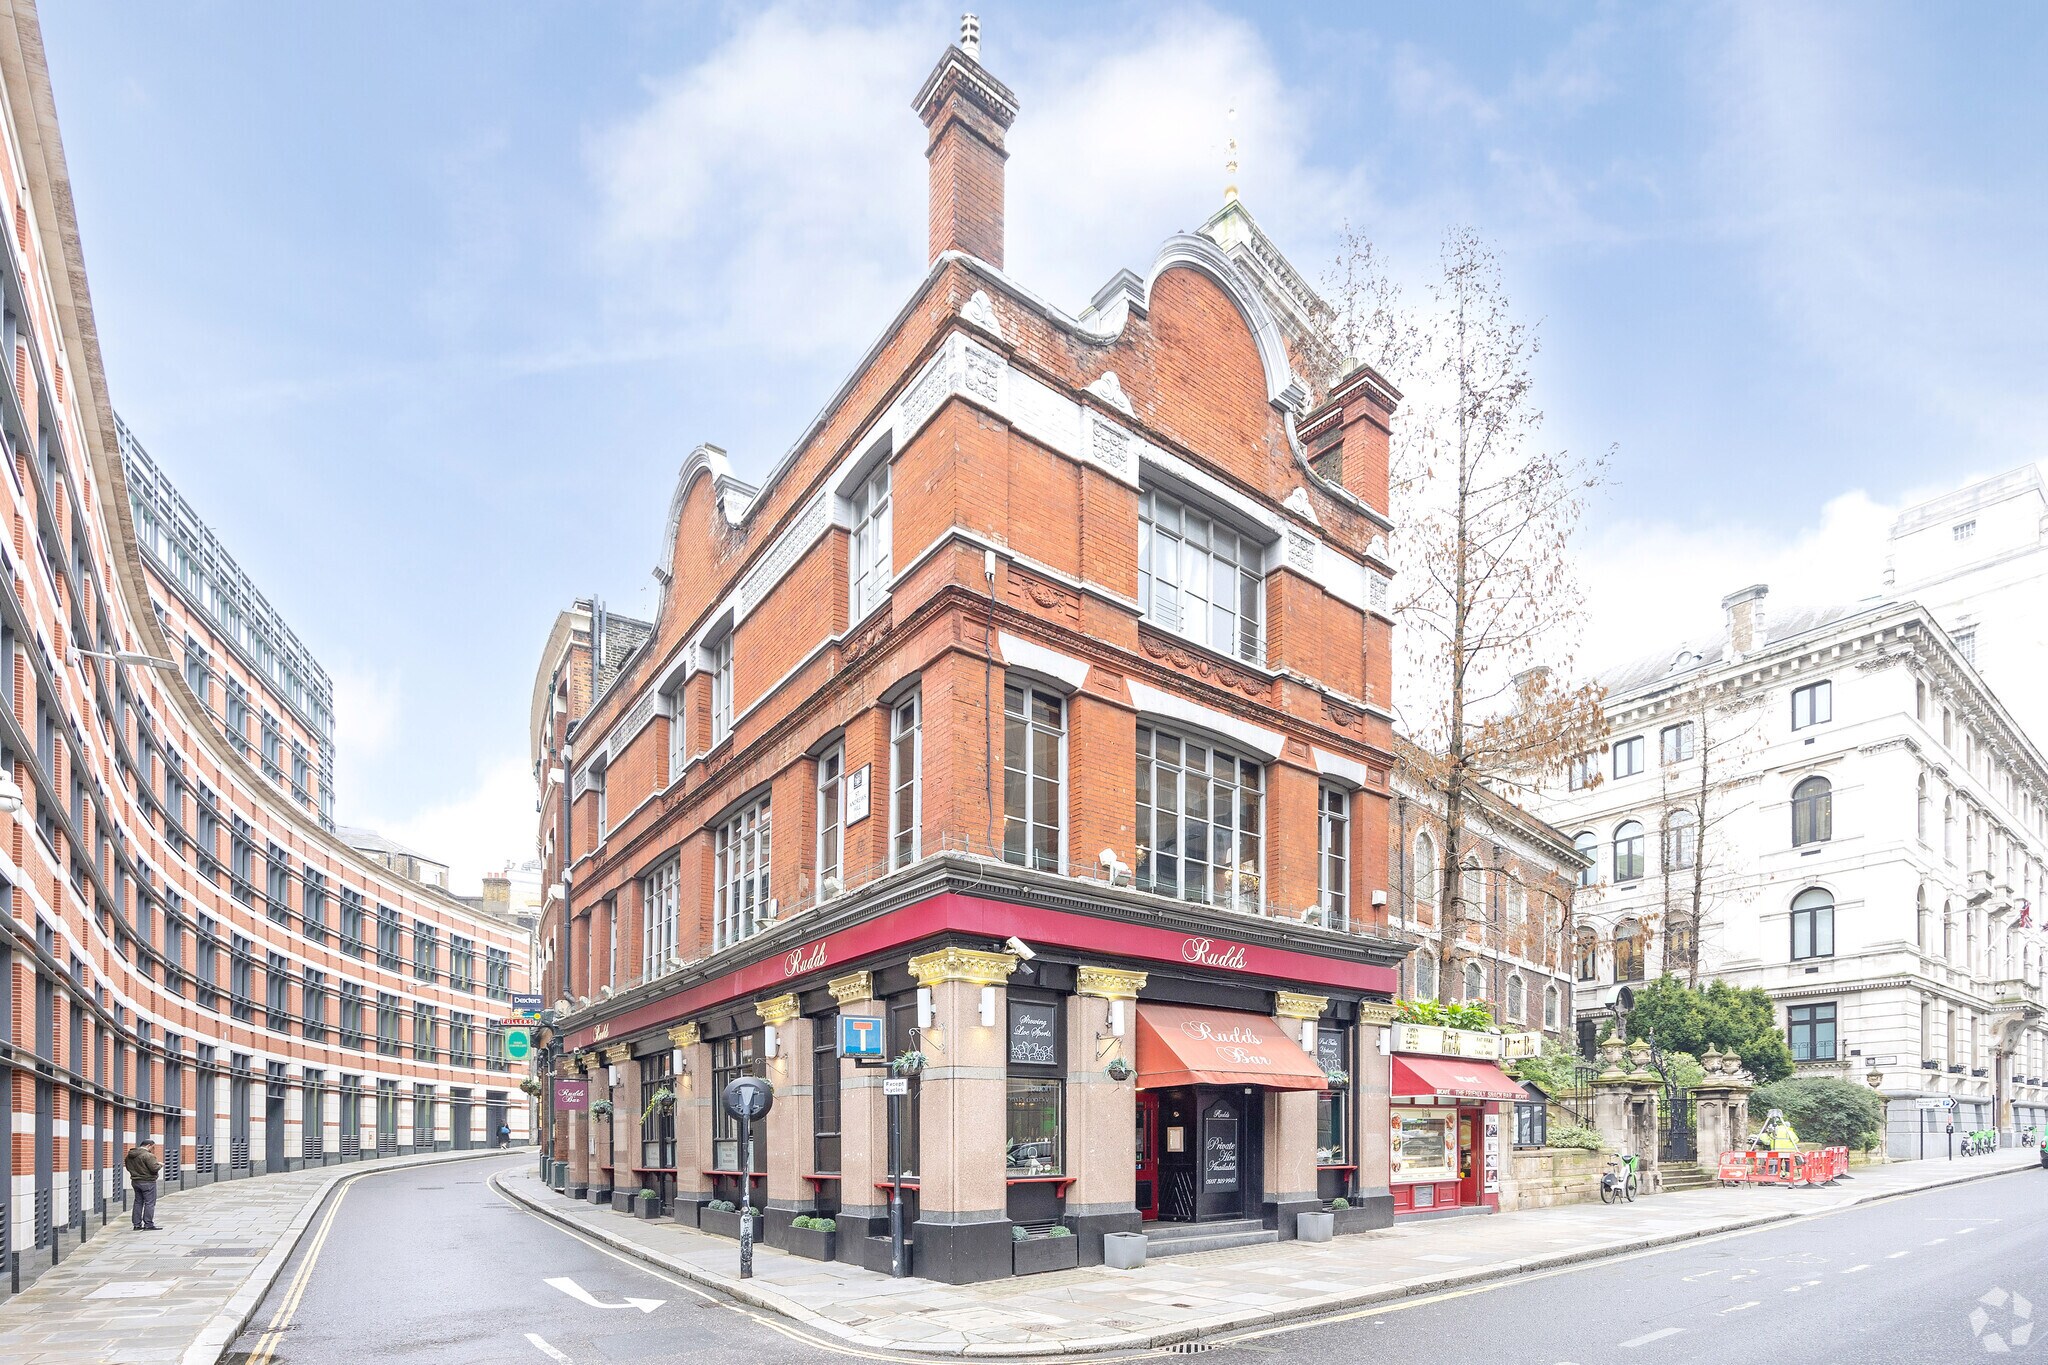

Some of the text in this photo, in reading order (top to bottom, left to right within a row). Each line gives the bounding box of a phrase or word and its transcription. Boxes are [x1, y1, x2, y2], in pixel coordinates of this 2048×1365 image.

[784, 942, 828, 977] Rudds
[1182, 937, 1248, 969] Rudds
[514, 996, 541, 1004] Dexters
[1019, 1014, 1047, 1028] Showing
[1013, 1024, 1052, 1038] Live Sports
[1181, 1020, 1263, 1045] Rudds
[1215, 1046, 1272, 1065] Bar
[558, 1088, 585, 1098] Rudds
[562, 1095, 581, 1103] Bar
[1213, 1110, 1230, 1118] Rudds
[1206, 1136, 1236, 1151] Private
[1219, 1150, 1236, 1162] Hire
[1206, 1160, 1236, 1172] Available
